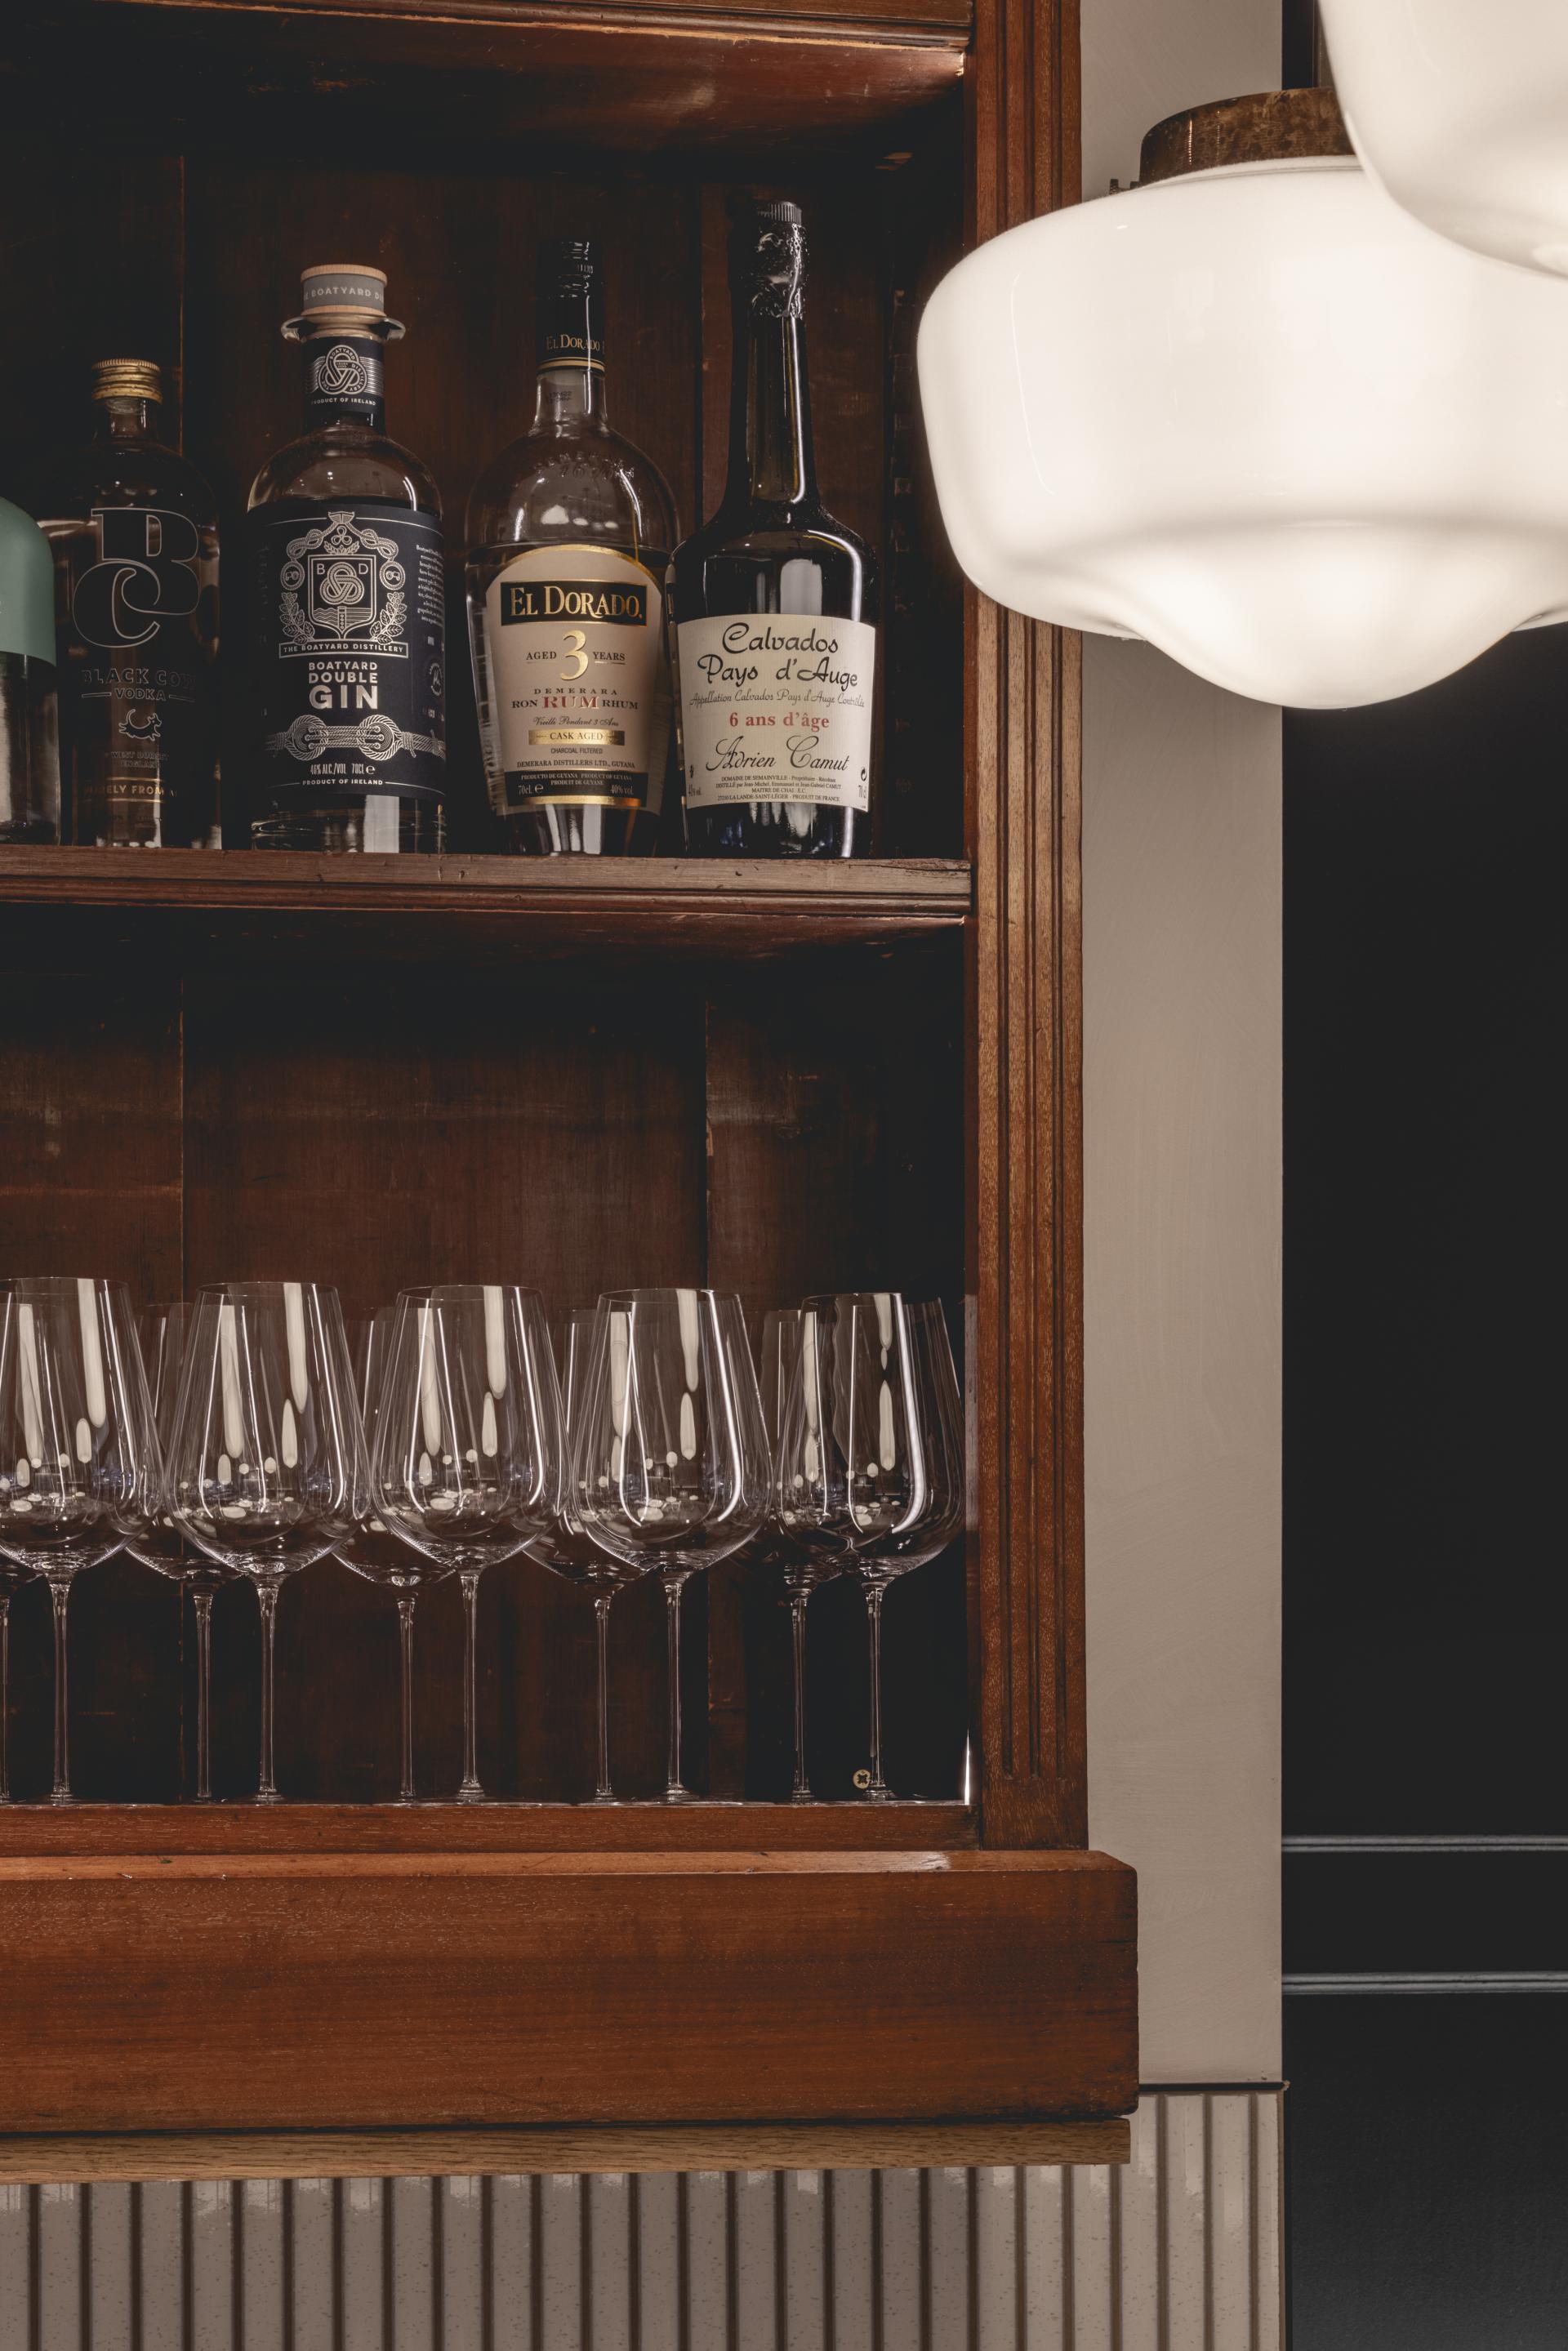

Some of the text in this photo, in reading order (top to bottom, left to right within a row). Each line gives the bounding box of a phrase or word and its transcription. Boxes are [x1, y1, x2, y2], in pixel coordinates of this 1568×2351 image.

[311, 287, 372, 297] BOATYARD
[546, 336, 559, 350] EL
[559, 334, 600, 351] DORADO
[329, 348, 356, 360] BOATYARD
[351, 398, 376, 406] IRELAND
[316, 563, 368, 575] B D
[510, 587, 538, 617] EL
[722, 622, 839, 654] Calvados
[301, 643, 349, 652] BOATYARD
[353, 643, 403, 652] DISTILLERY
[526, 651, 626, 661] AGED YEARS
[560, 630, 589, 681] 3
[309, 661, 378, 670] BOATYARD
[81, 667, 149, 685] BLACK
[309, 672, 378, 683] DOUBLE
[697, 653, 858, 692] Pays d'Auge
[115, 688, 167, 701] VODKA
[309, 684, 378, 710] GIN
[689, 692, 732, 709] Appellation
[734, 688, 774, 701] Calvados
[776, 688, 801, 706] Pays
[511, 696, 639, 710] RON RUM RHUM
[559, 715, 593, 726] Pendant
[599, 718, 619, 727] Ans
[729, 712, 830, 732] 6 ans d'âge
[550, 732, 604, 740] CASK AGED
[706, 736, 850, 772] Adrien Camut
